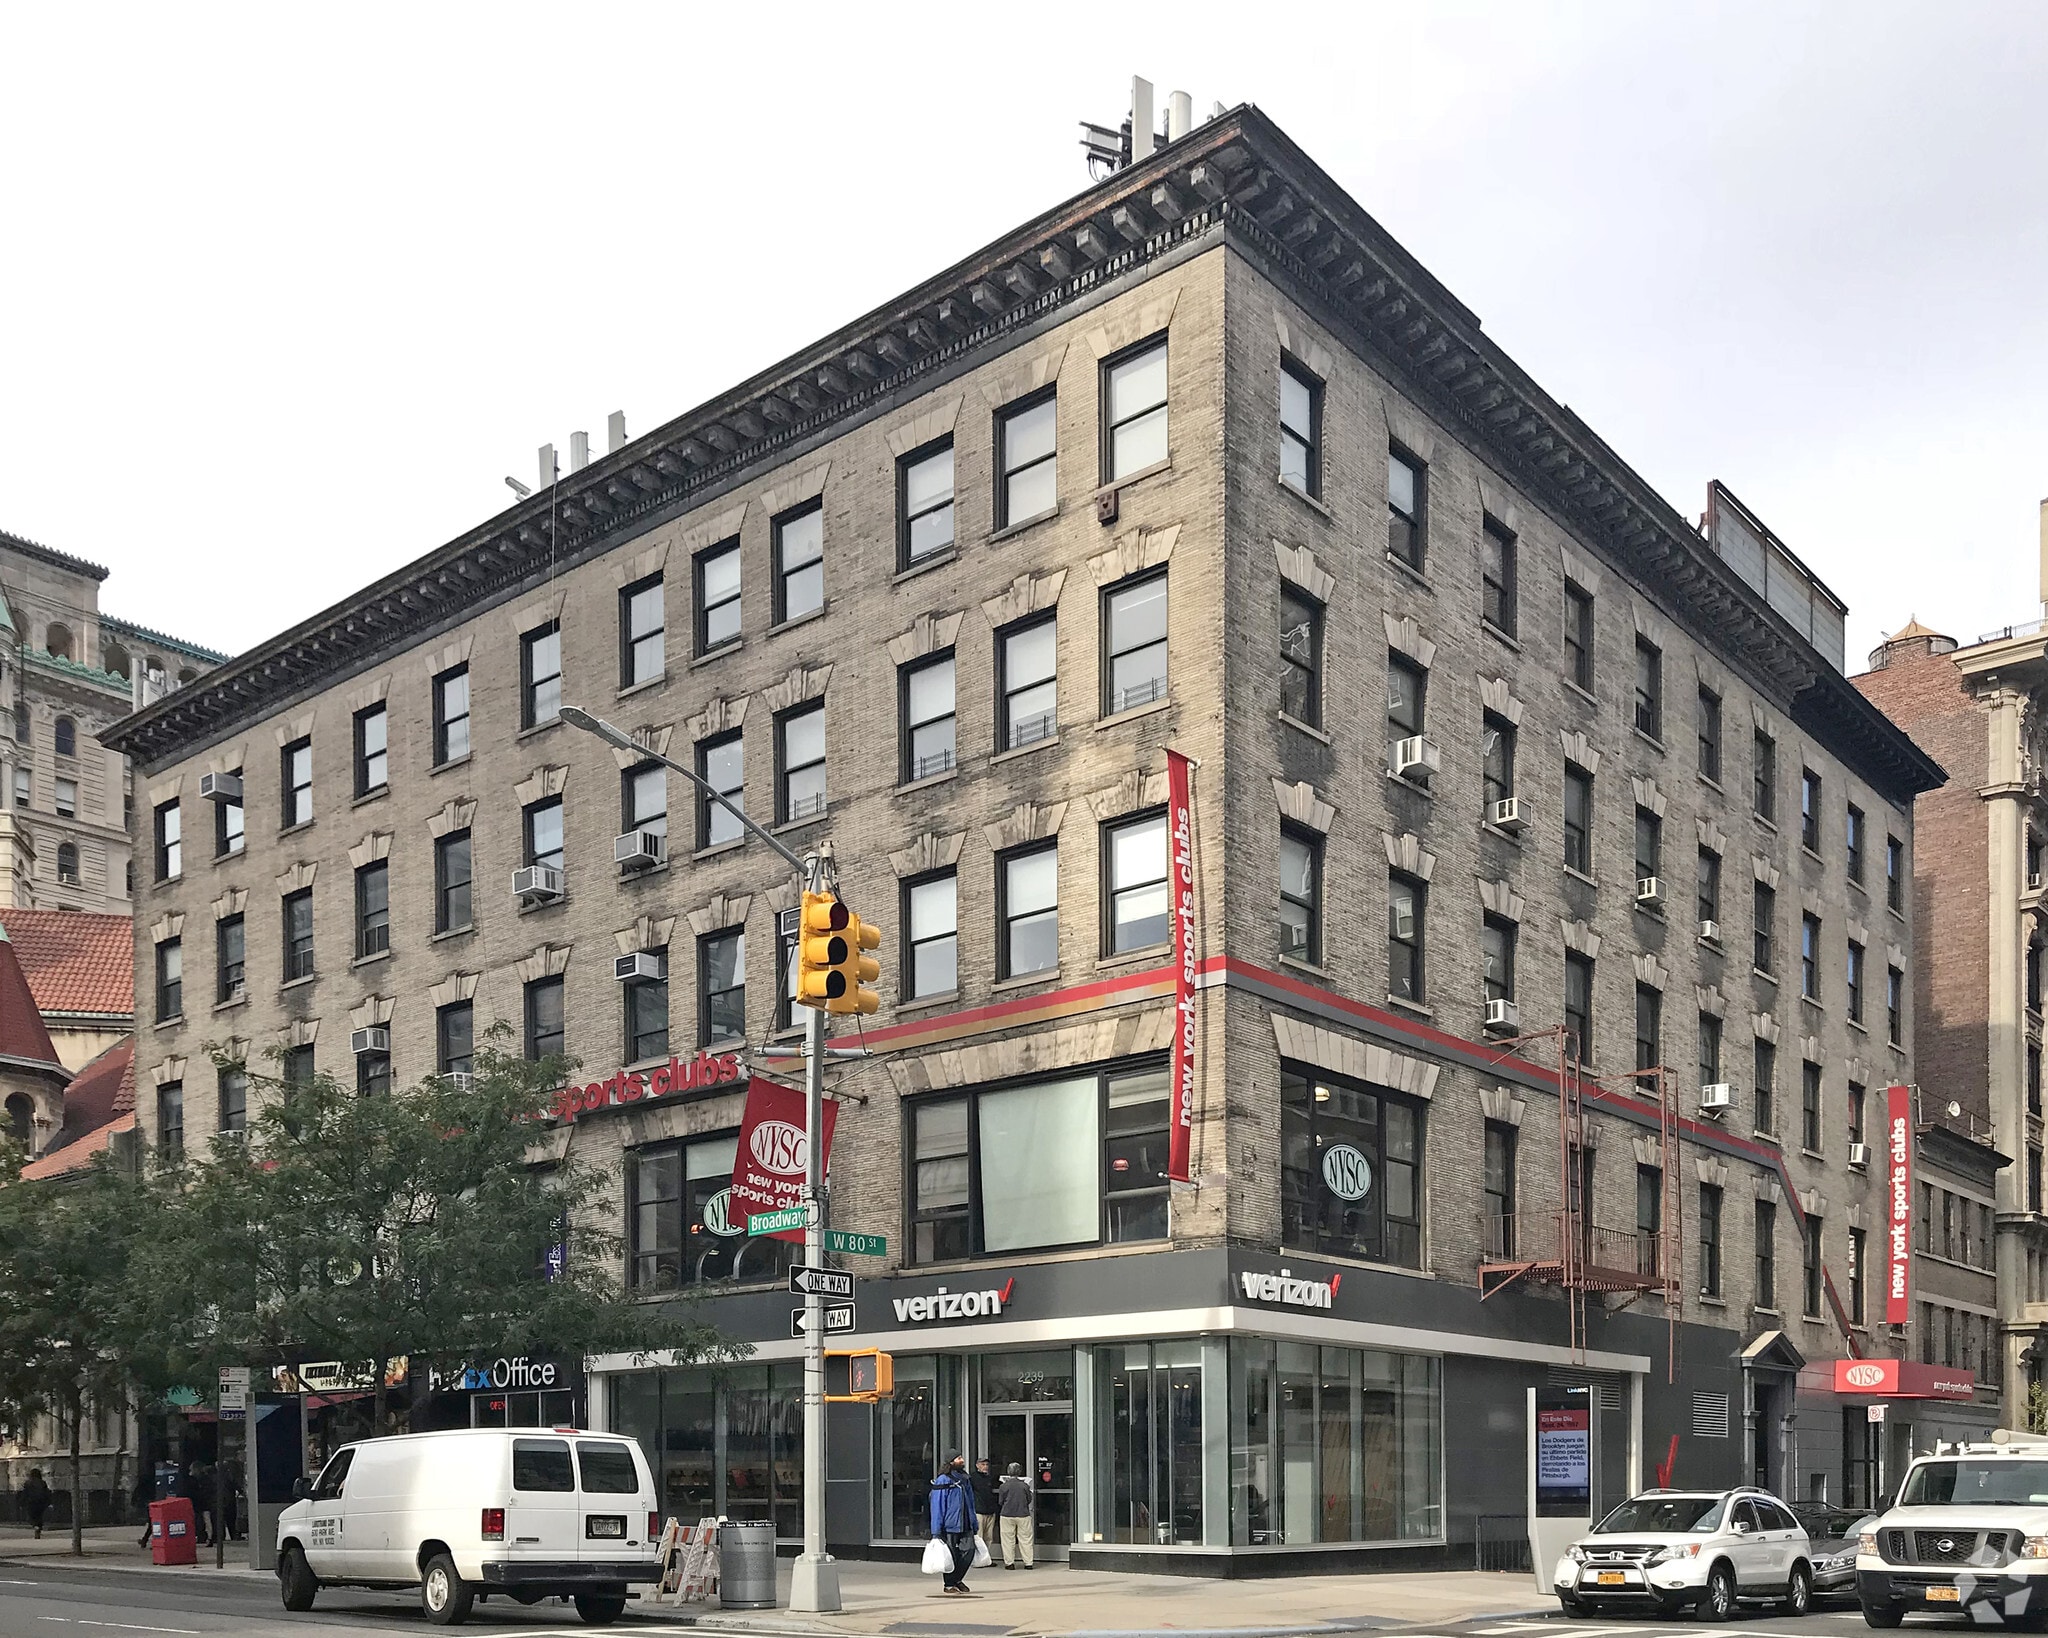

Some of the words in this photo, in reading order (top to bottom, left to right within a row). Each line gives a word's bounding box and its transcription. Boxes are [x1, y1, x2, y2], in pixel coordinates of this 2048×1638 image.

[1174, 807, 1193, 885] clubs
[1178, 891, 1196, 985] sports
[550, 1070, 646, 1123] sports
[651, 1050, 740, 1097] clubs
[1179, 1068, 1194, 1128] new
[757, 1125, 807, 1170] NYSC
[1890, 1117, 1906, 1163] clubs
[746, 1173, 773, 1189] new
[1328, 1150, 1366, 1196] NYSC
[732, 1183, 775, 1206] sports
[1890, 1165, 1909, 1220] sports
[751, 1210, 807, 1232] Broadway
[833, 1233, 845, 1250] W
[849, 1235, 866, 1251] 80
[1890, 1223, 1909, 1260] york
[807, 1273, 826, 1290] ONE
[828, 1275, 848, 1293] WAY
[1242, 1268, 1332, 1308] verizon
[1892, 1264, 1905, 1299] new
[828, 1310, 848, 1327] WAY
[892, 1286, 1002, 1322] verizon
[492, 1356, 556, 1388] Office
[1017, 1370, 1044, 1383] 2239
[1850, 1367, 1881, 1385] NYSC
